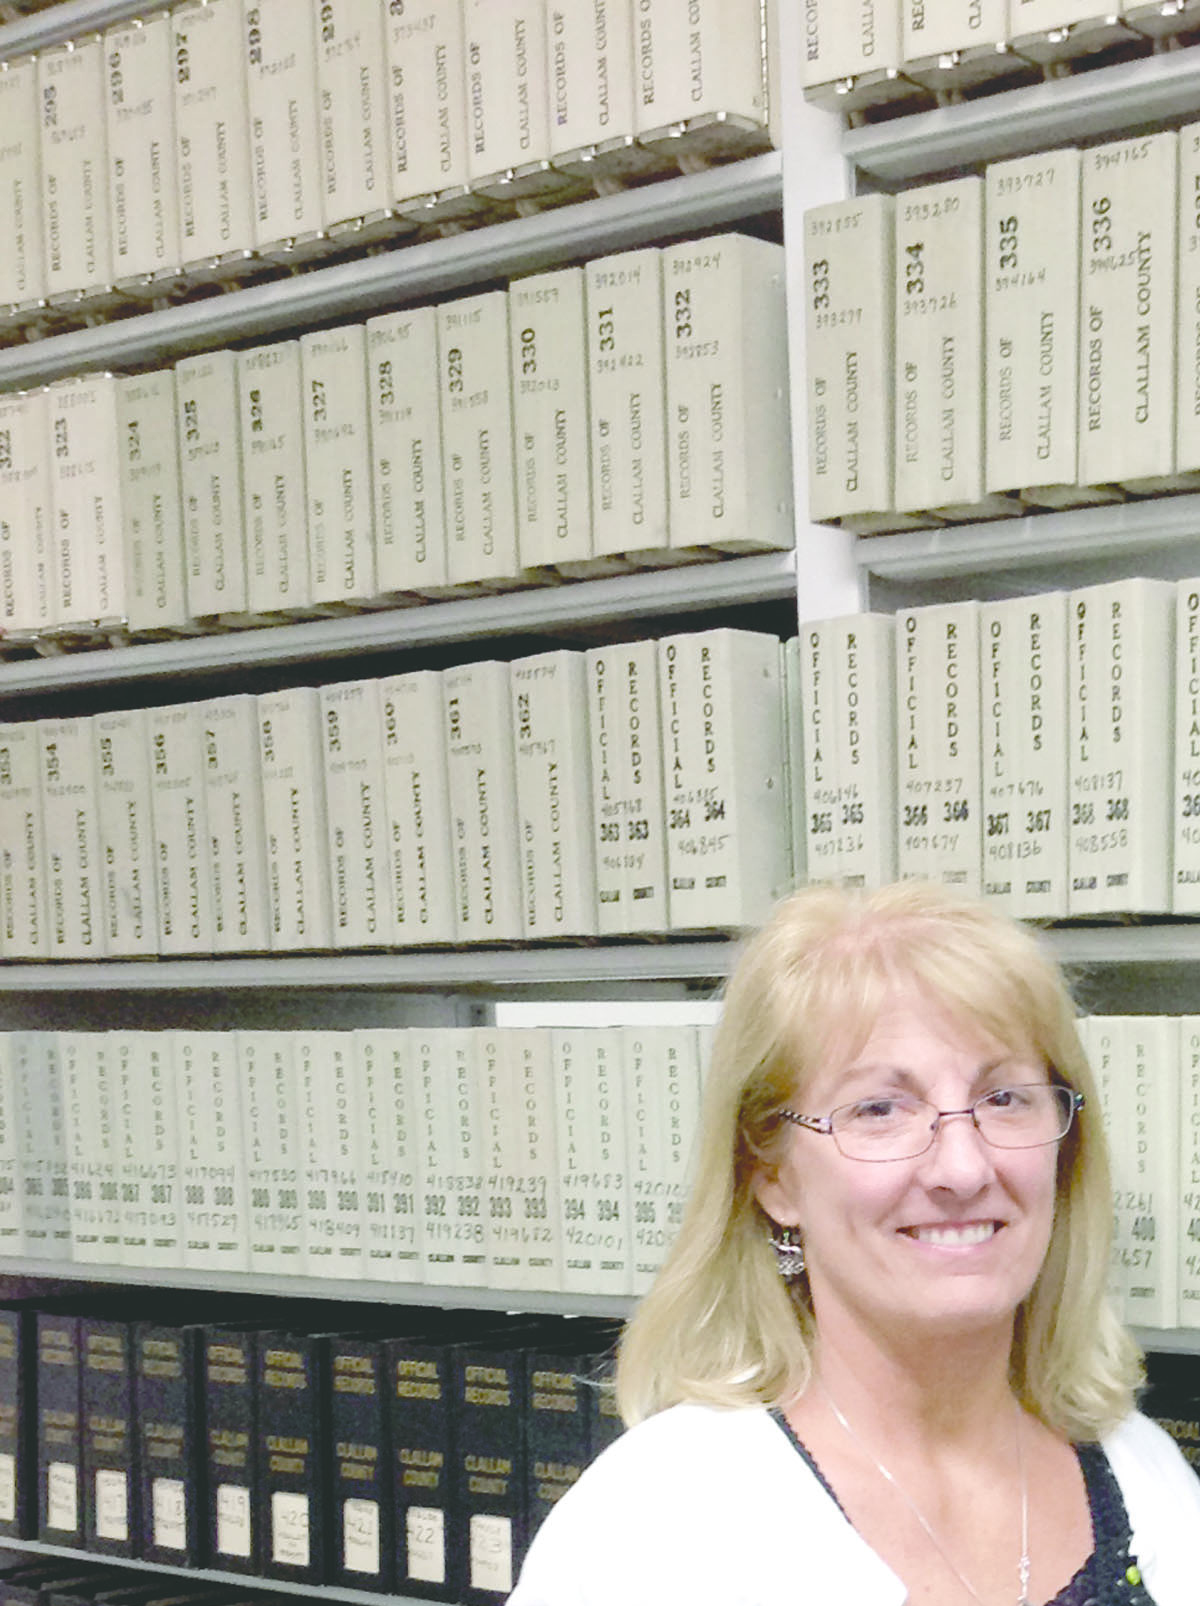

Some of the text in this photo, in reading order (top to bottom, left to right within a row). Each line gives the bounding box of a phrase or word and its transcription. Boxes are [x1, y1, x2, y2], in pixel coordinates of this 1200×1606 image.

[999, 215, 1020, 269] 335
[1092, 197, 1112, 251] 336
[812, 259, 831, 310] 333
[904, 242, 925, 295] 334
[599, 306, 616, 352] 331
[675, 289, 692, 341] 332
[1136, 230, 1152, 425] CLALLAM COUNTY
[448, 348, 464, 392] 329
[521, 328, 538, 375] 330
[1088, 306, 1102, 430] RECORDS OF
